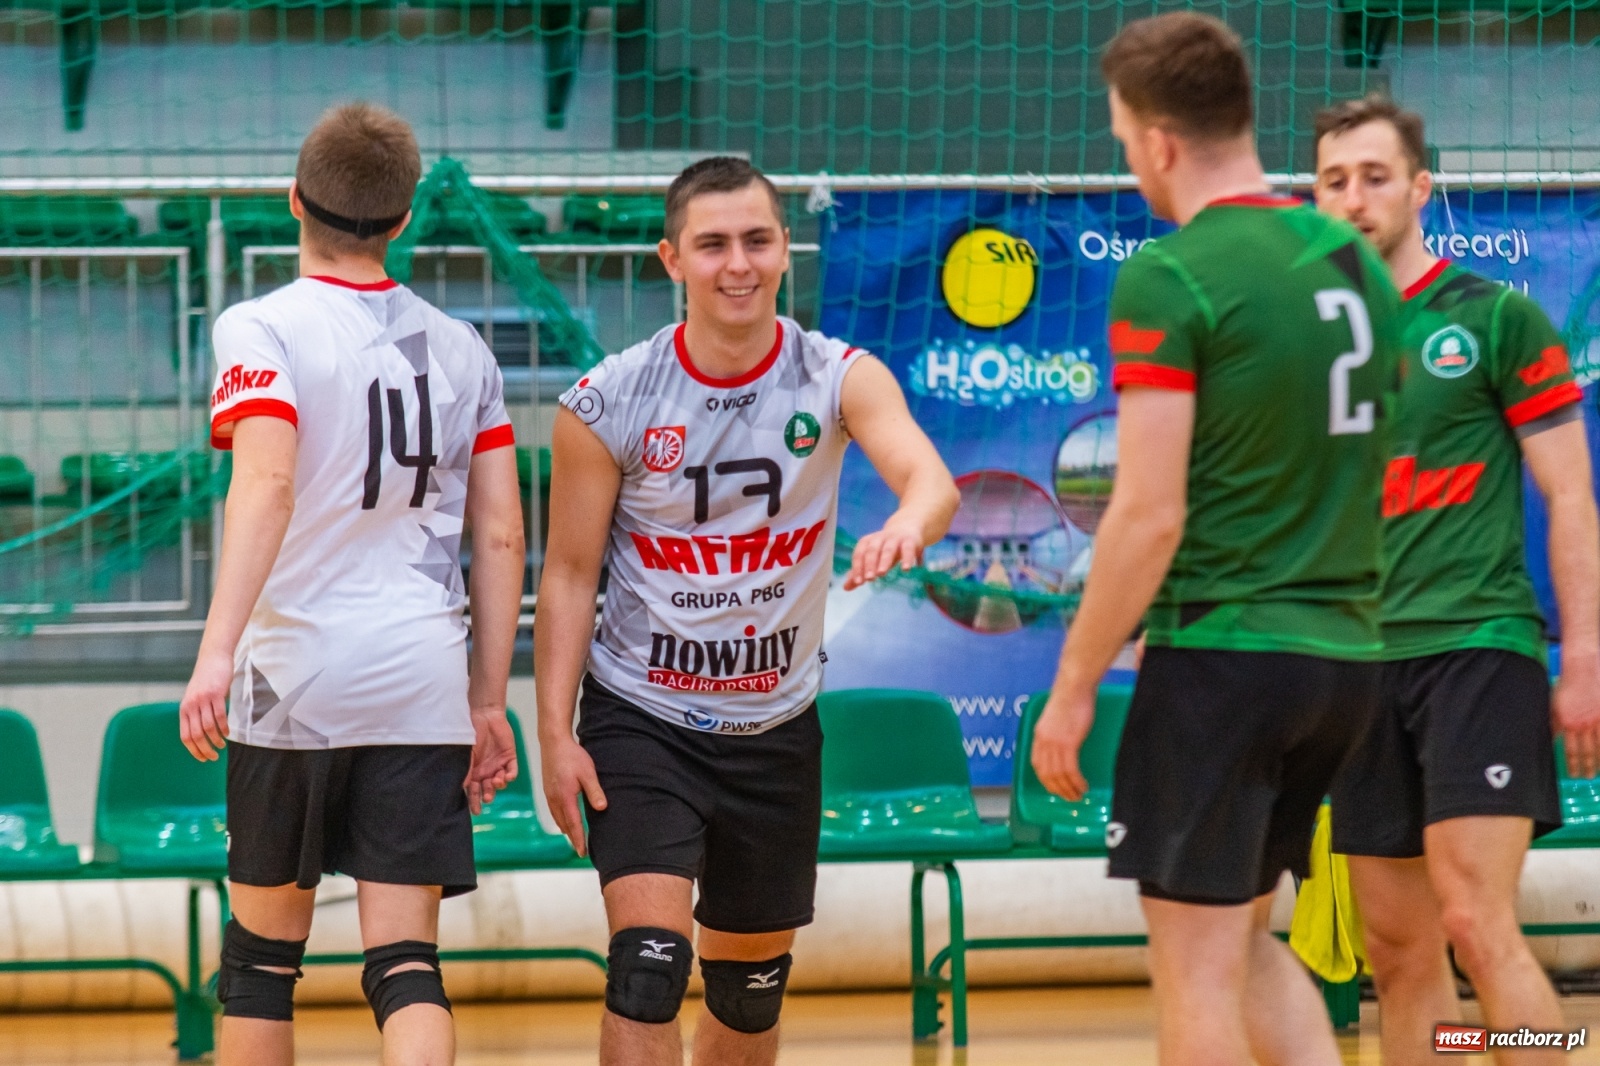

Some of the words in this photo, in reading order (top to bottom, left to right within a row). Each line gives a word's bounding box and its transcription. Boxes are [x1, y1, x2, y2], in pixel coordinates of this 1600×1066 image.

[1314, 288, 1374, 435] 2
[361, 373, 438, 510] 14
[671, 591, 742, 609] GRUPA
[750, 582, 785, 605] PBG
[648, 624, 799, 677] nowiny
[639, 949, 673, 962] MIZUNO
[746, 980, 779, 989] MIZUNO
